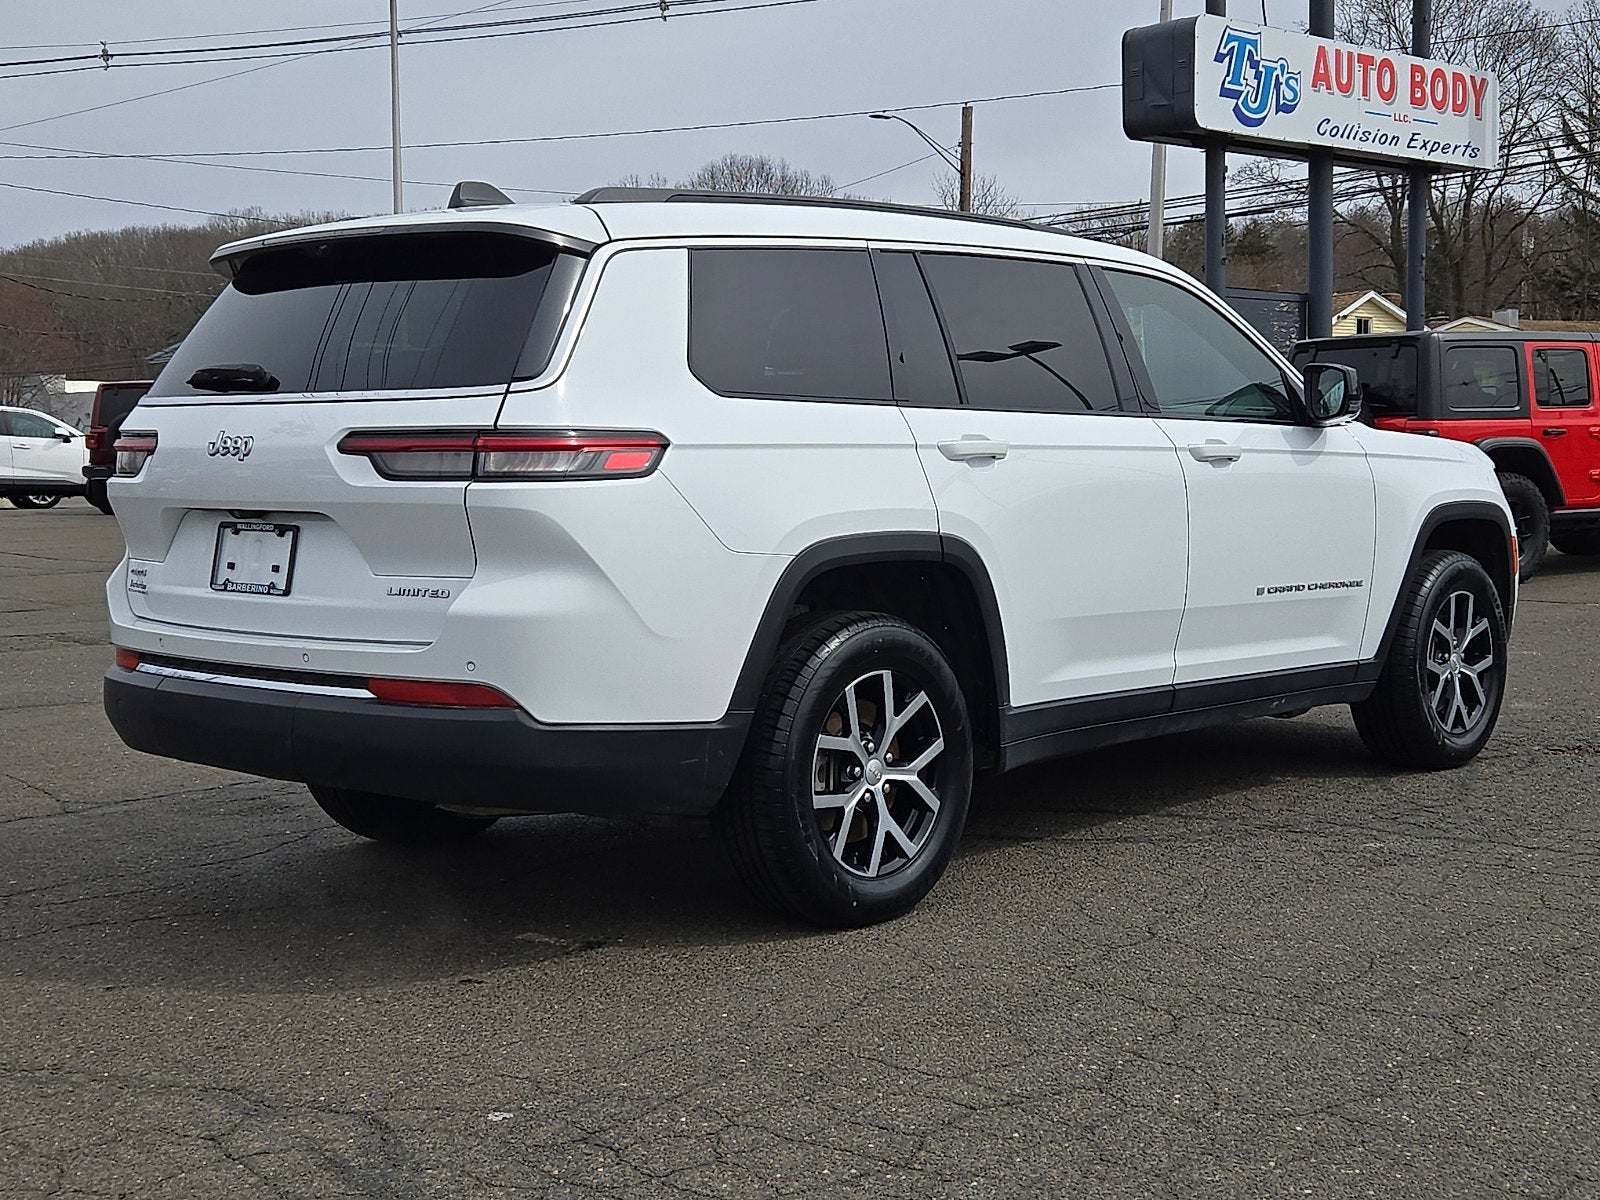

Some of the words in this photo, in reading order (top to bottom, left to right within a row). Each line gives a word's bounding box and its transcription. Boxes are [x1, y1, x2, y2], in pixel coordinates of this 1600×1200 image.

[1213, 25, 1301, 128] TJ's
[1311, 45, 1398, 105] AUTO
[1409, 63, 1489, 120] BODY
[1393, 112, 1411, 125] LLC.
[1316, 117, 1399, 147] Collision
[1406, 131, 1481, 160] Experts
[207, 430, 255, 462] Jeep
[236, 522, 275, 531] WALLINGFORD
[226, 582, 269, 594] BARBERINO
[386, 585, 451, 599] LIMITED
[1266, 583, 1306, 595] GRAND
[1307, 579, 1364, 591] CHEROKEE
